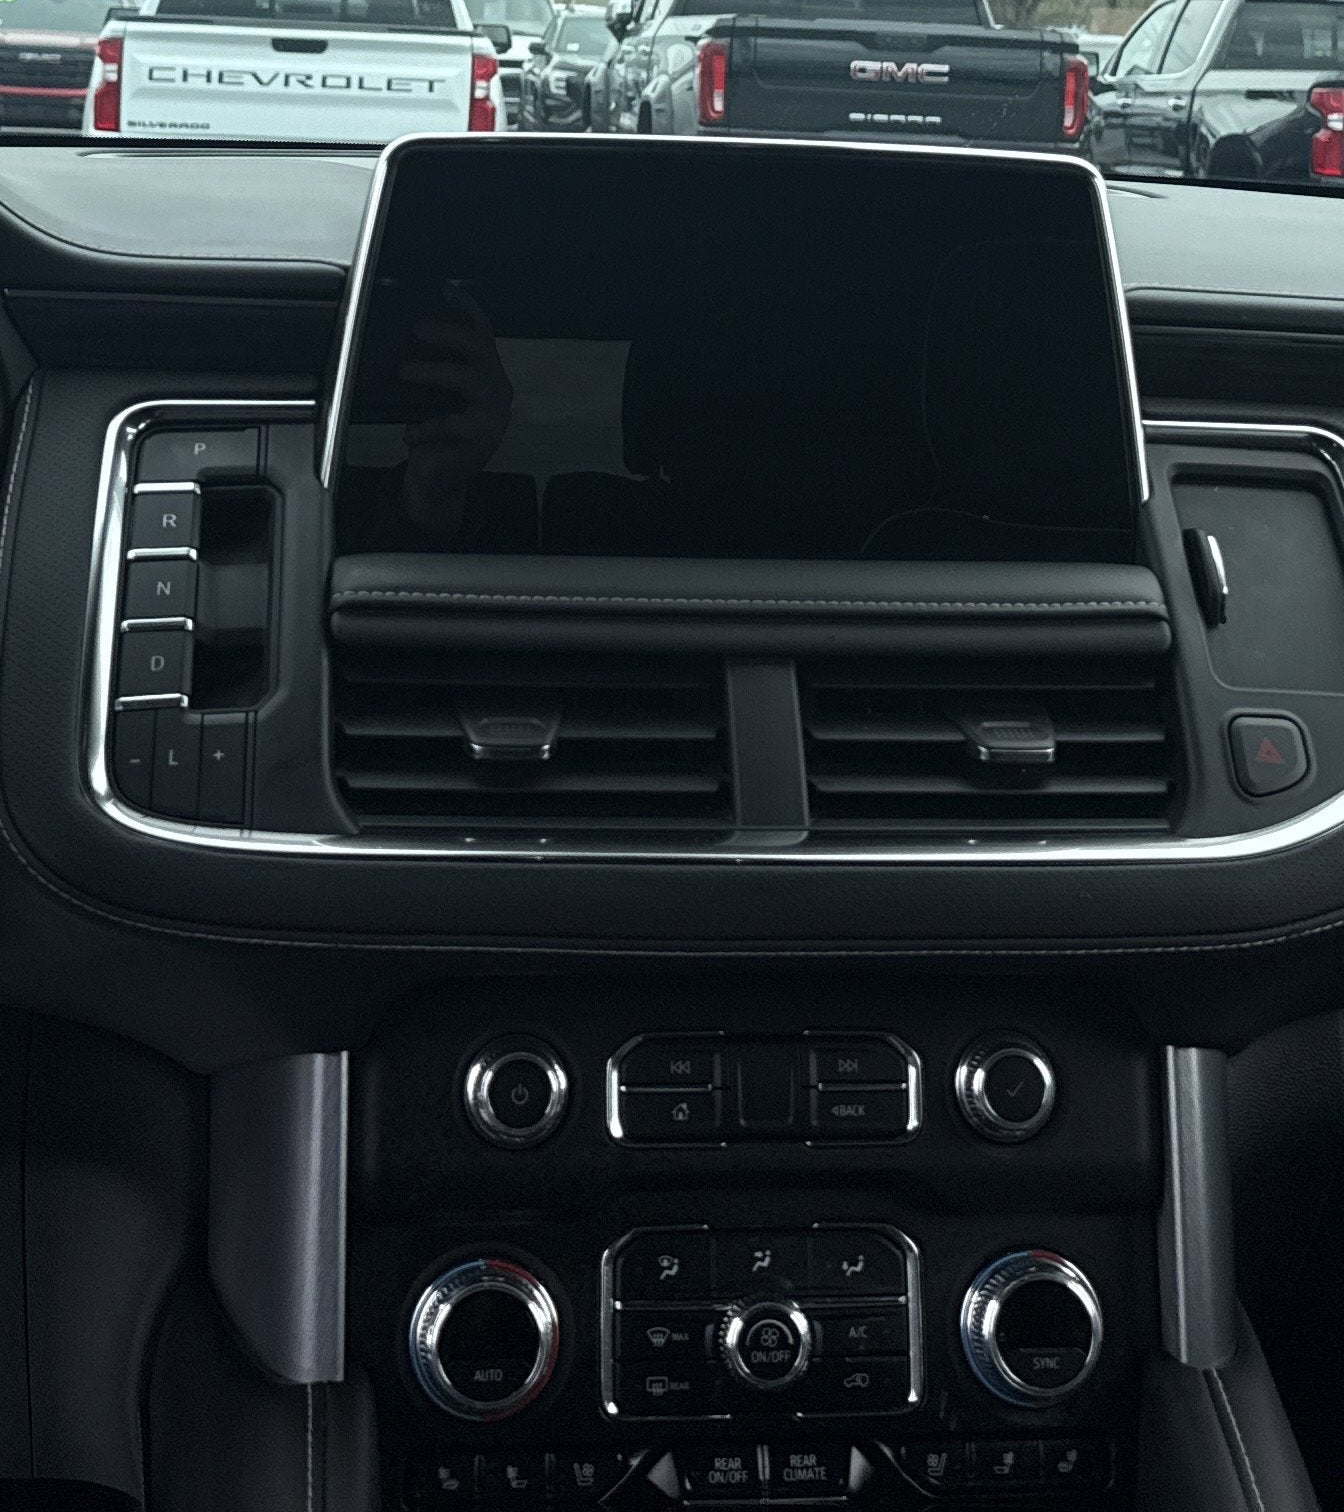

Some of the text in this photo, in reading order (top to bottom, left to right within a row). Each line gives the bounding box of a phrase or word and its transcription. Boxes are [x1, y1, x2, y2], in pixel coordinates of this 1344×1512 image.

[147, 66, 446, 94] CHEVROLET
[849, 60, 950, 85] GMC
[127, 120, 211, 130] SILVERADO
[193, 442, 206, 455] P
[161, 513, 177, 528] R
[156, 580, 172, 596] N
[150, 655, 165, 671] D
[168, 750, 179, 766] L
[839, 1104, 866, 1118] BACK
[847, 1325, 869, 1339] A/C
[751, 1349, 791, 1364] ON/OFF
[1032, 1355, 1061, 1370] SYNC
[474, 1367, 504, 1383] AUTO
[713, 1456, 743, 1470] REAR
[789, 1453, 818, 1467] REAR
[708, 1469, 749, 1484] ON/OFF
[782, 1466, 828, 1482] CLIMATE
